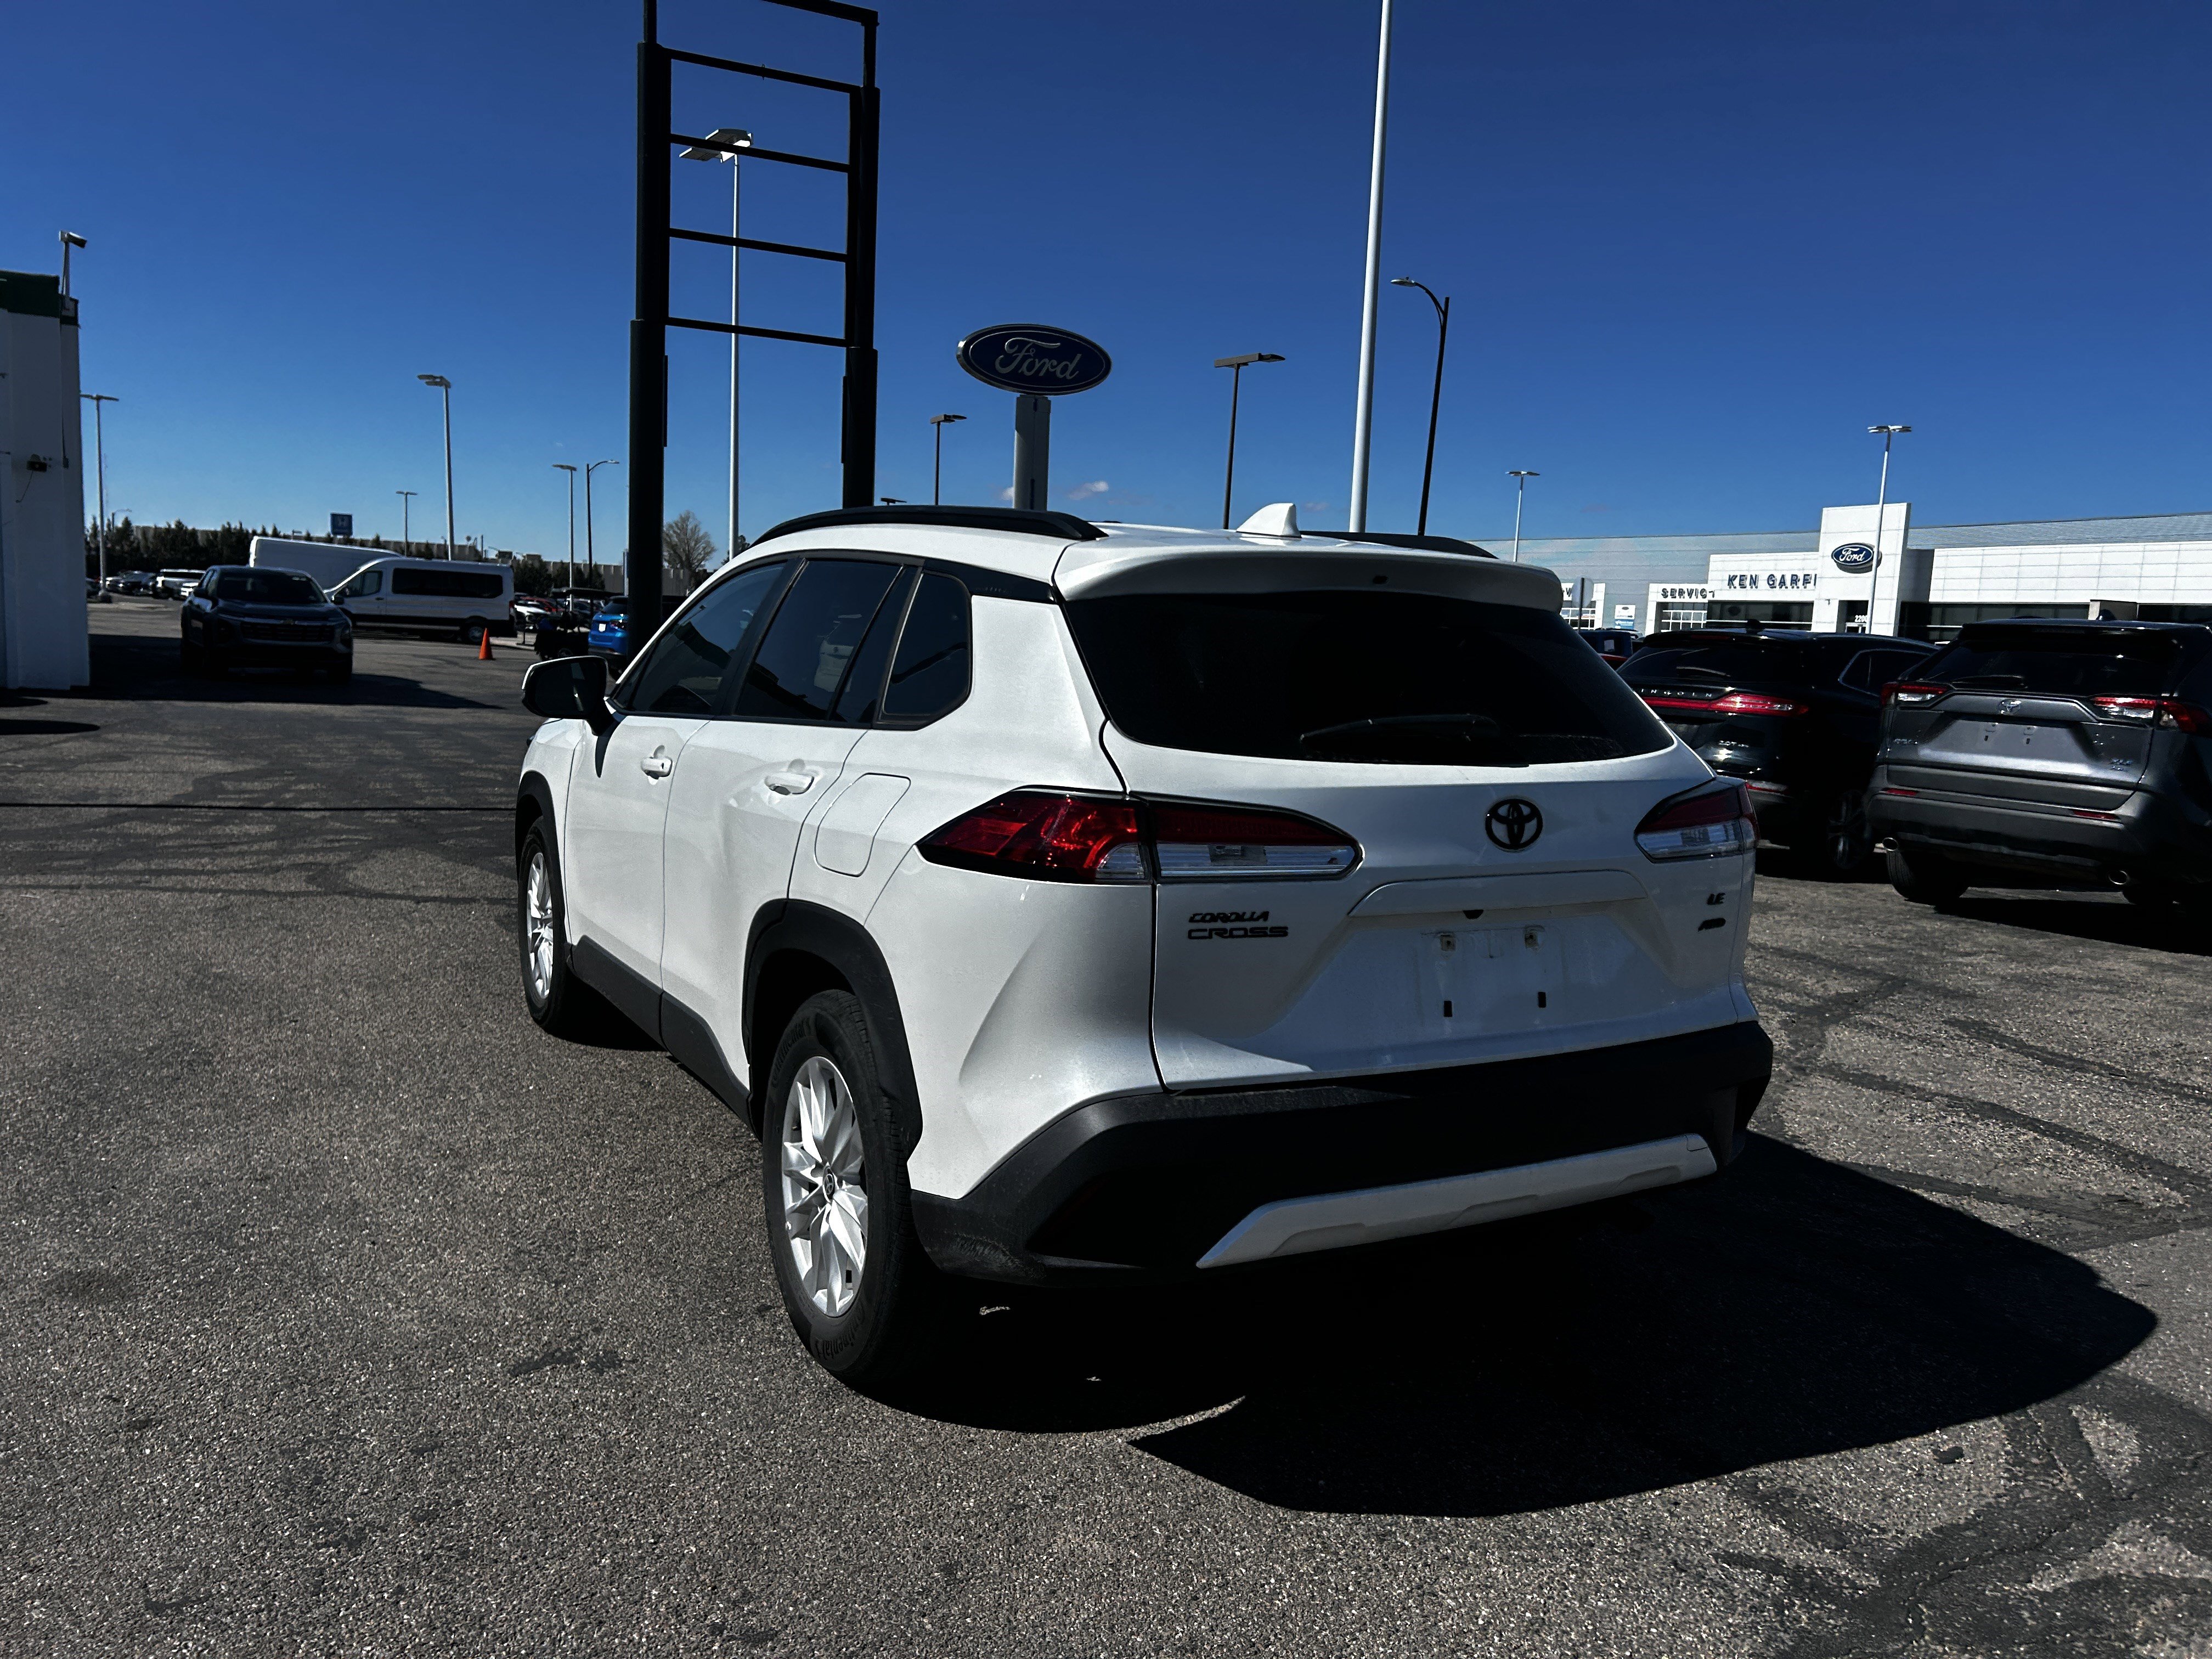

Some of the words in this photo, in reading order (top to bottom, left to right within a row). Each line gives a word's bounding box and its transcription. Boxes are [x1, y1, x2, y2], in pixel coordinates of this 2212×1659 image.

[995, 337, 1082, 379] Ford
[1839, 548, 1866, 562] Ford
[1728, 574, 1758, 588] KEN
[1661, 588, 1707, 599] SERVIC
[1641, 688, 1712, 697] INCOLN
[1707, 893, 1725, 905] LE
[1188, 911, 1269, 923] COROLLA
[1188, 926, 1288, 939] CROSS
